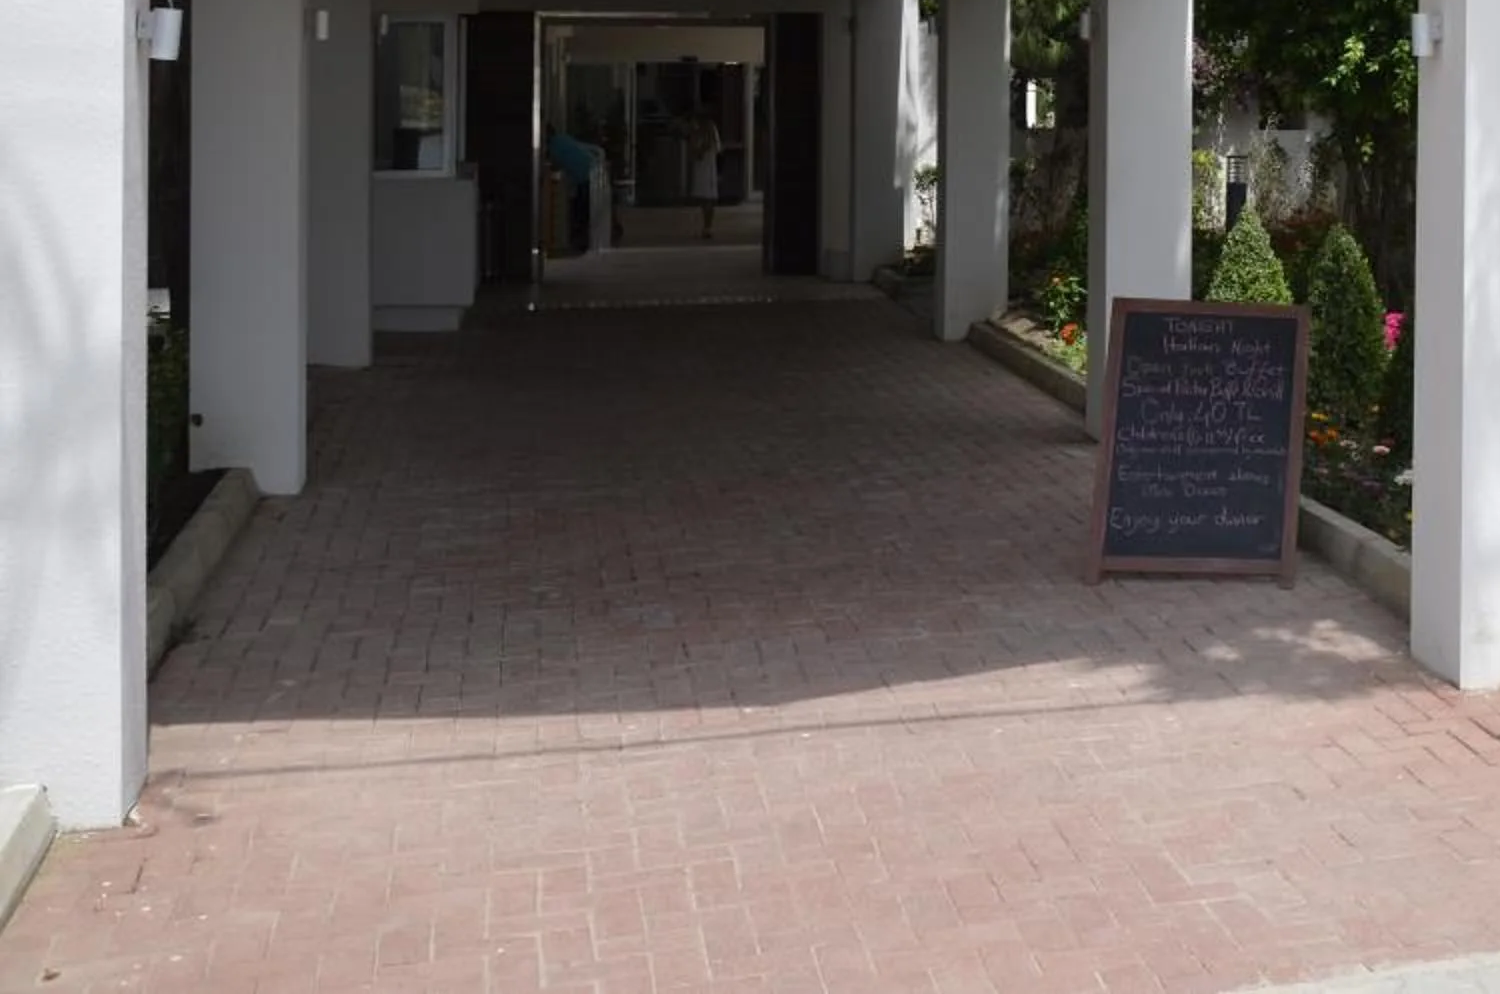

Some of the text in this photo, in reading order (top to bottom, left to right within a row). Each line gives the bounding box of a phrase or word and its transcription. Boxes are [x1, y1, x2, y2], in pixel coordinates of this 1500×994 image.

[1233, 401, 1262, 422] TL
[1111, 507, 1164, 535] Enjoy
[1168, 514, 1207, 534] your
